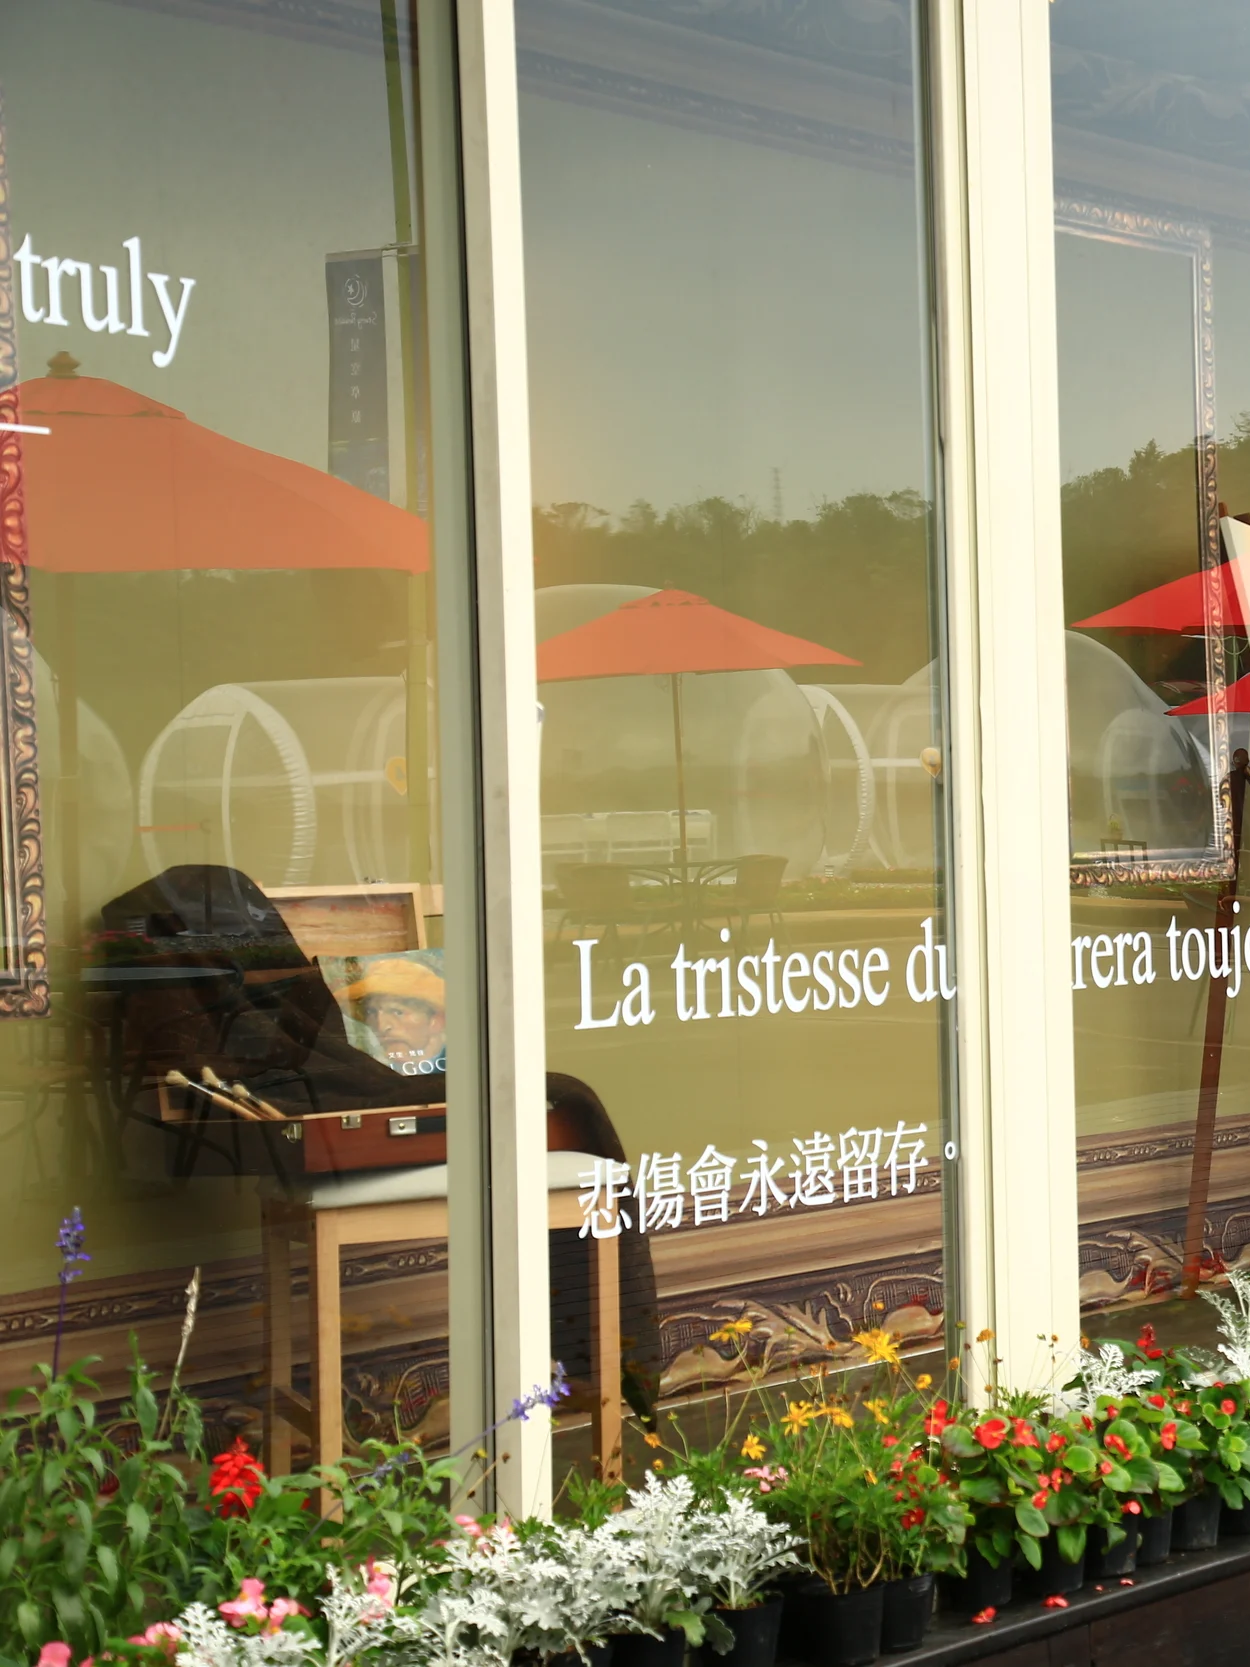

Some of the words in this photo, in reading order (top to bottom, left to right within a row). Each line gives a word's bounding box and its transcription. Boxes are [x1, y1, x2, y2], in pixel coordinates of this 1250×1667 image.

[13, 232, 196, 368] truly
[571, 937, 656, 1031] La
[670, 928, 890, 1022] tristesse
[577, 1120, 957, 1240] 悲傷會永遠留存。
